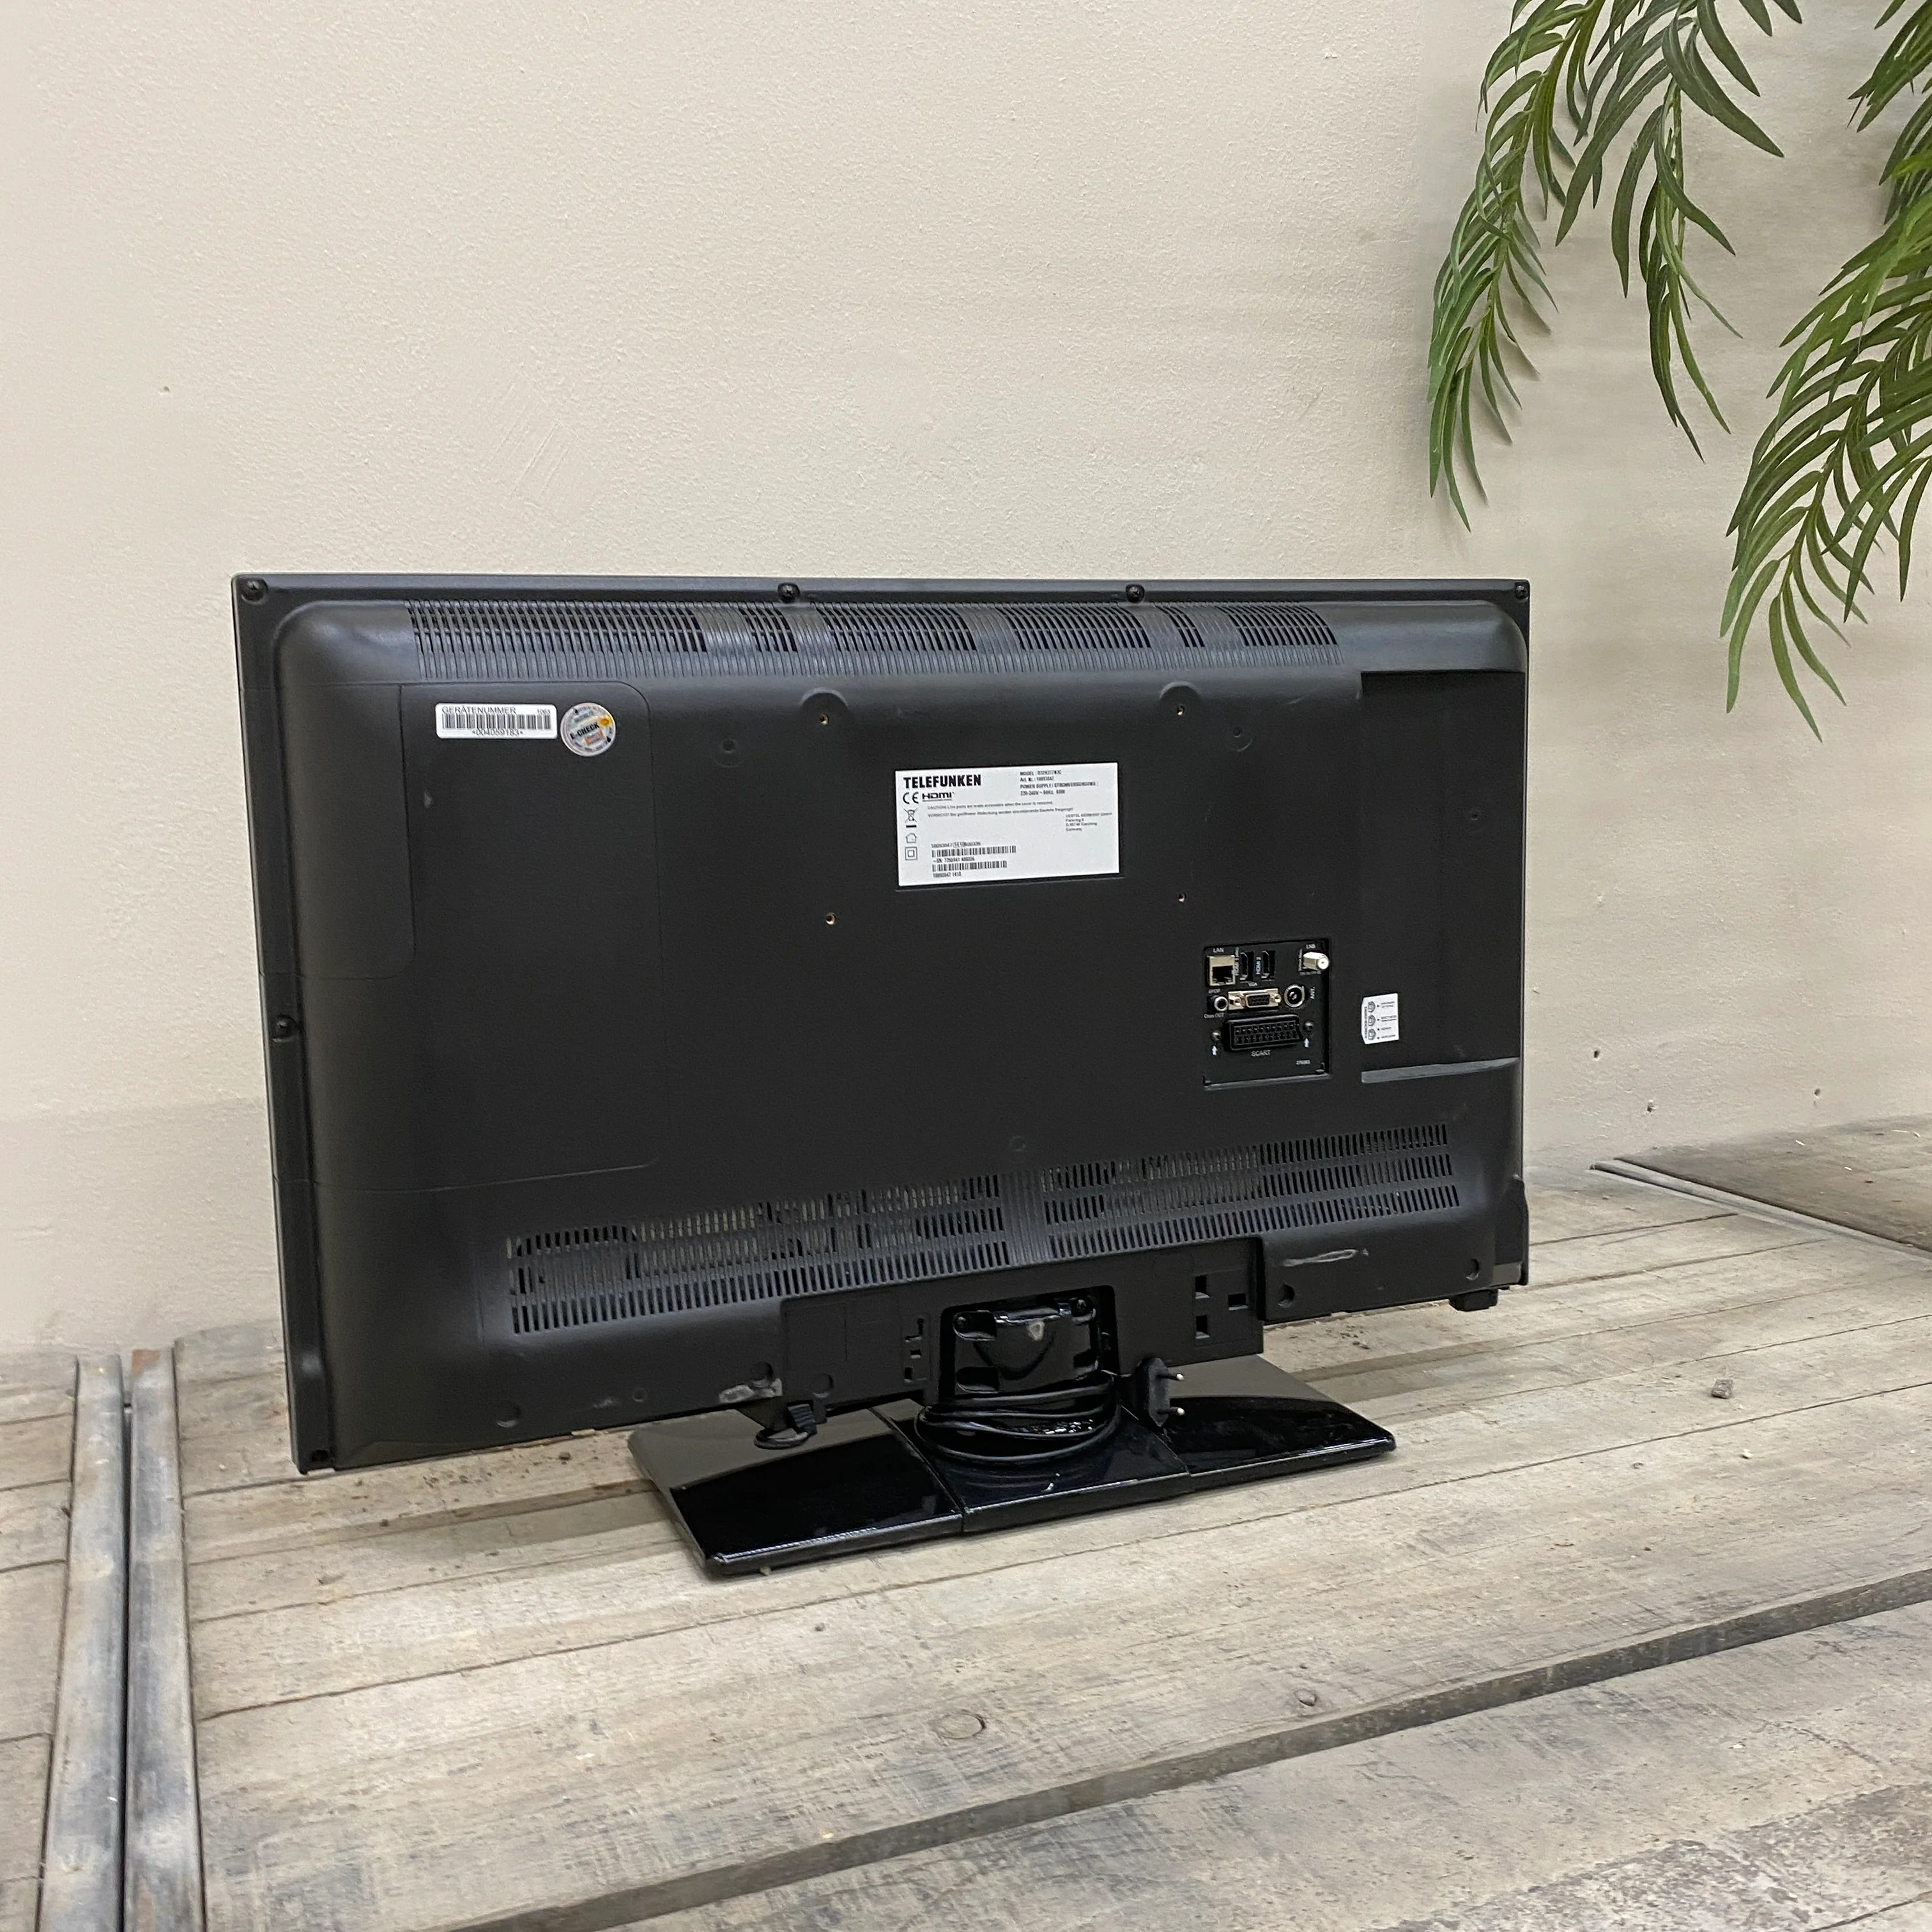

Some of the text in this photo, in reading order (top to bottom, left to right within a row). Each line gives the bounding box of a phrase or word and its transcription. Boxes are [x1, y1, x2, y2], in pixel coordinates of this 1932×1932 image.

[442, 705, 516, 714] GERÄTENUMMER
[903, 774, 981, 789] TELEFUNKEN
[1251, 1049, 1271, 1057] SCART
